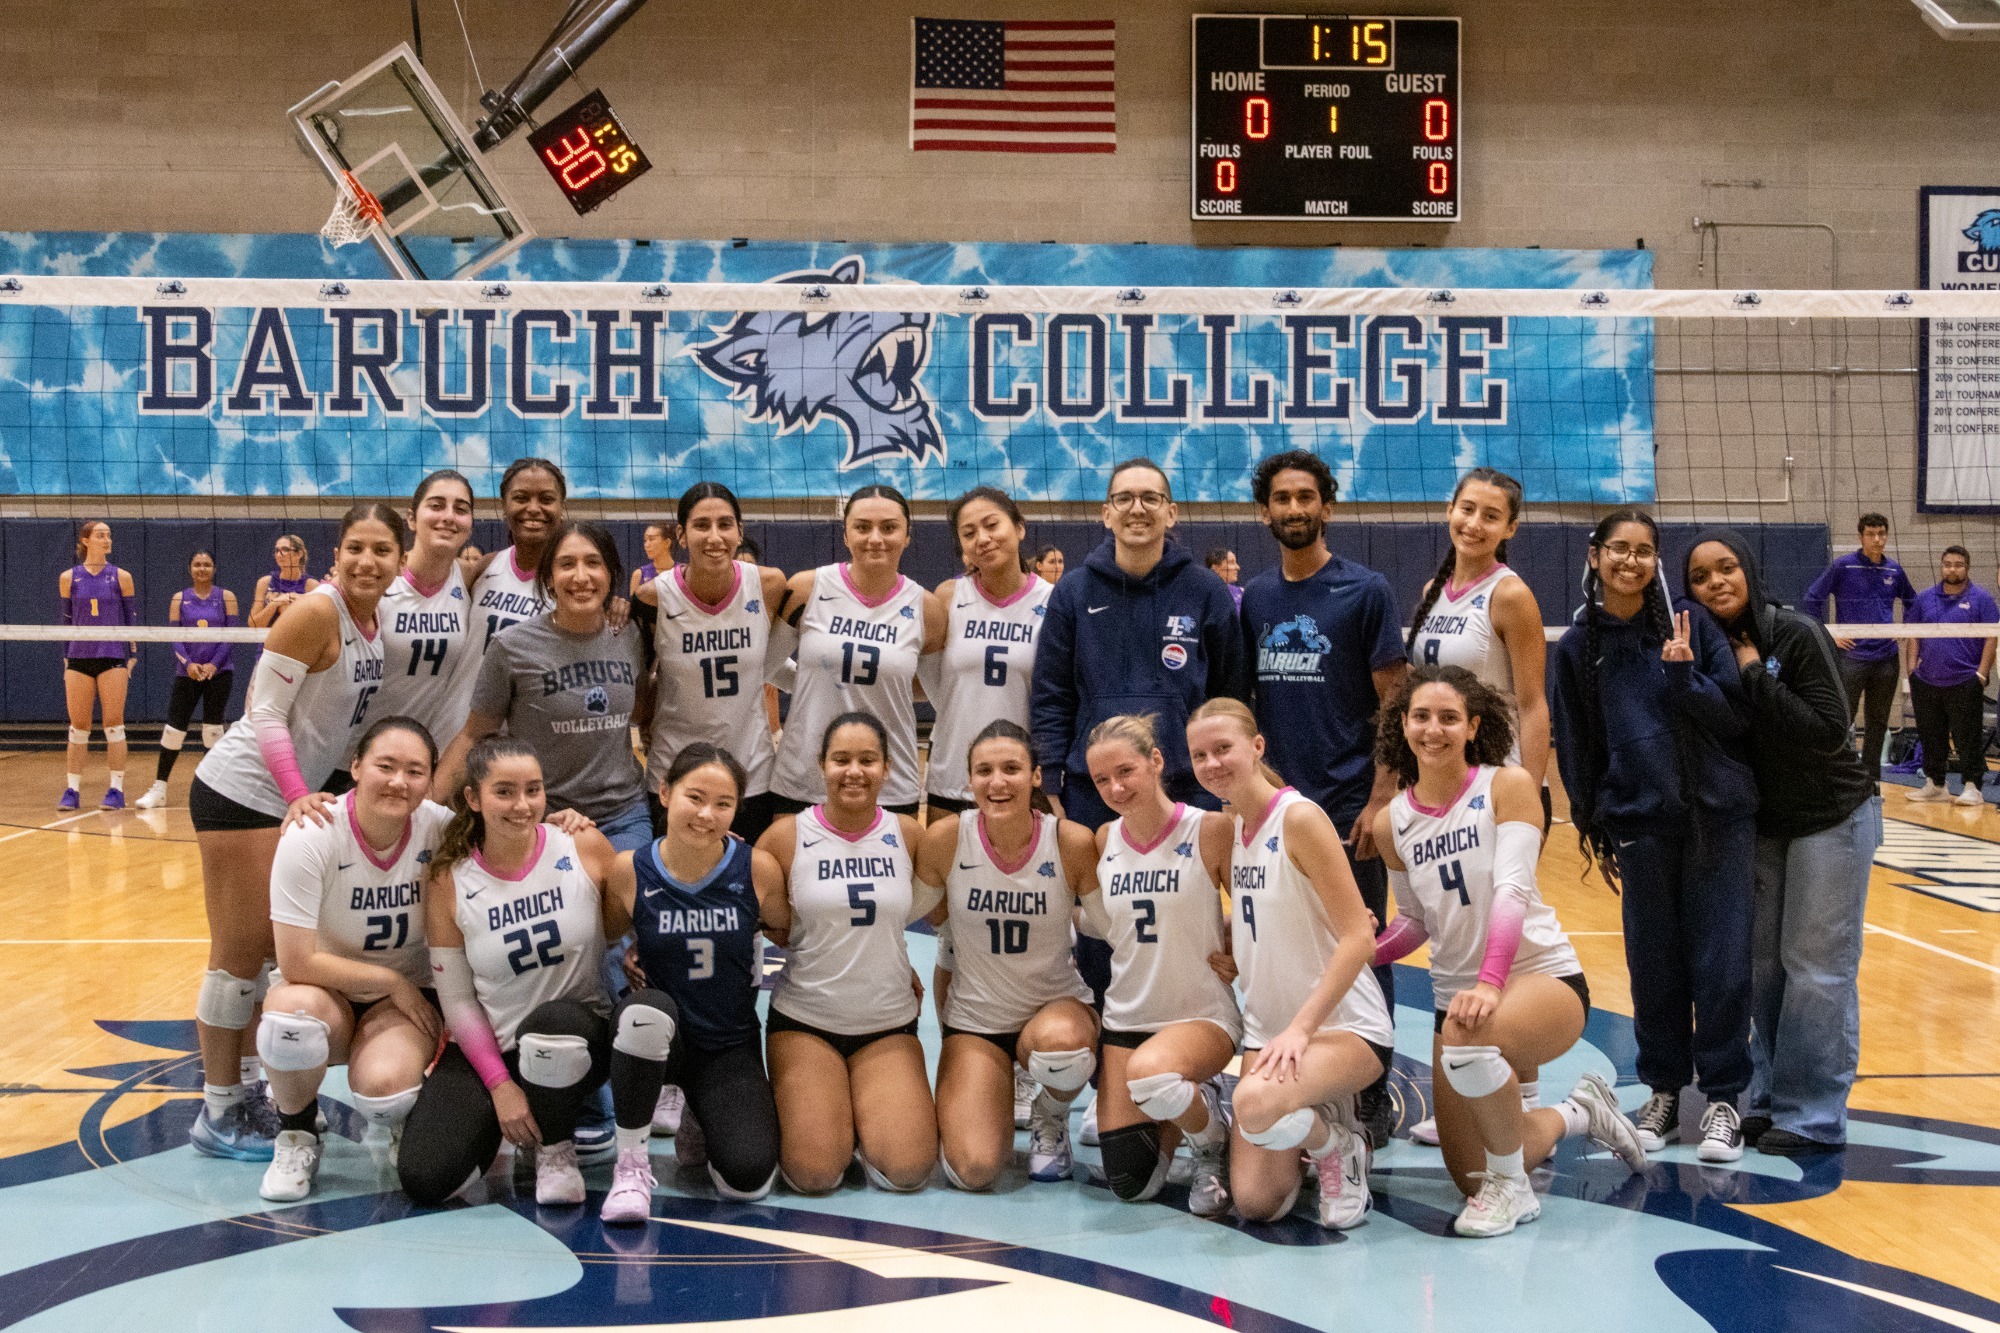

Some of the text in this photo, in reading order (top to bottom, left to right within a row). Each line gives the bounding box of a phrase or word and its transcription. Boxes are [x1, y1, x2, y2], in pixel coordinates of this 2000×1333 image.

[1313, 23, 1387, 64] 1:15
[1211, 72, 1266, 92] HOME
[1304, 84, 1350, 98] PERIOD
[1385, 73, 1446, 94] GUEST
[1246, 98, 1269, 139] 0
[1330, 105, 1338, 134] 1
[1425, 100, 1448, 140] 0
[1200, 144, 1241, 158] FOULS
[1285, 145, 1373, 160] PLAYER FOUL
[1412, 146, 1453, 161] FOULS
[1217, 161, 1235, 192] 0
[1429, 163, 1447, 194] 0
[1200, 200, 1242, 214] SCORE
[1305, 200, 1348, 215] MATCH
[1412, 201, 1454, 216] SCORE
[137, 306, 1508, 424] BARUCH COLLEGE
[89, 598, 99, 617] 1
[479, 589, 545, 617] BARUCH
[395, 612, 460, 634] BARUCH
[482, 614, 521, 656] 1
[829, 616, 897, 645] BARUCH
[964, 620, 1033, 644] BARUCH
[682, 627, 751, 654] BARUCH
[407, 638, 448, 675] 14
[841, 641, 880, 686] 13
[984, 645, 1008, 687] 6
[1257, 647, 1320, 671] BARUCH
[542, 660, 634, 697] BARUCH
[700, 655, 739, 698] 15
[349, 686, 378, 727] 16
[551, 712, 631, 734] VOLLEYBAL
[1413, 825, 1480, 866] BARUCH
[818, 856, 896, 881] BARUCH
[1110, 869, 1179, 897] BARUCH
[1438, 860, 1471, 906] 4
[350, 880, 421, 911] BARUCH
[488, 886, 565, 931] BARUCH
[846, 883, 876, 927] 5
[967, 888, 1047, 915] BARUCH
[363, 912, 409, 951] 21
[658, 907, 739, 934] BARUCH
[1132, 899, 1157, 944] 2
[1241, 895, 1256, 943] 9
[503, 919, 565, 976] 22
[985, 918, 1030, 955] 10
[687, 938, 715, 980] 3
